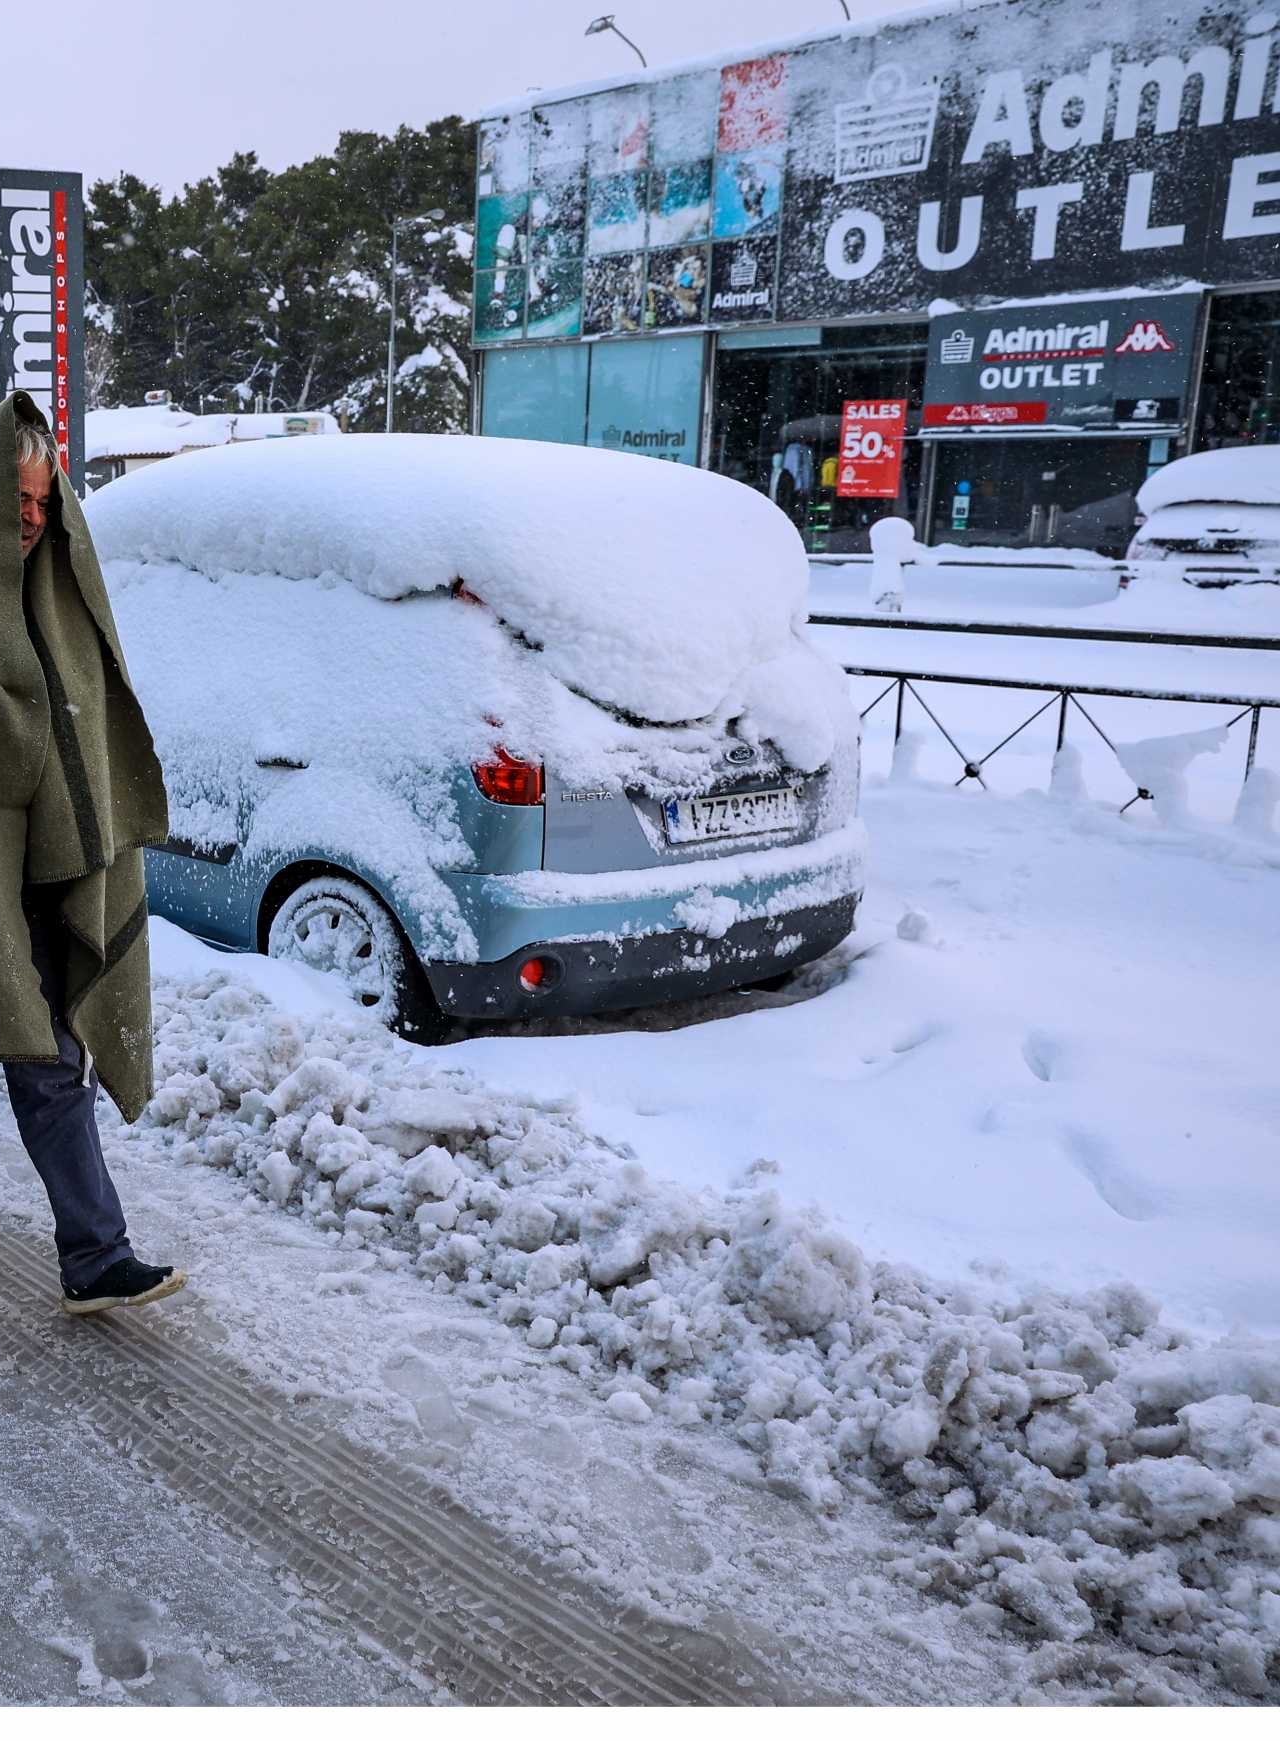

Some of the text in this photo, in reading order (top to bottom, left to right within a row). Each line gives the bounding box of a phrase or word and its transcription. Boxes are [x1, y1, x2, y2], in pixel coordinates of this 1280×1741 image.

[960, 13, 1280, 165] Admi
[712, 287, 769, 309] Admiral
[56, 231, 68, 452] SPORT SHOPS
[983, 320, 1109, 354] Admiral
[979, 362, 1105, 390] OUTLET
[847, 404, 901, 420] SALES
[622, 428, 686, 447] Admiral
[842, 431, 896, 458] 50%
[562, 790, 615, 802] FIESTA
